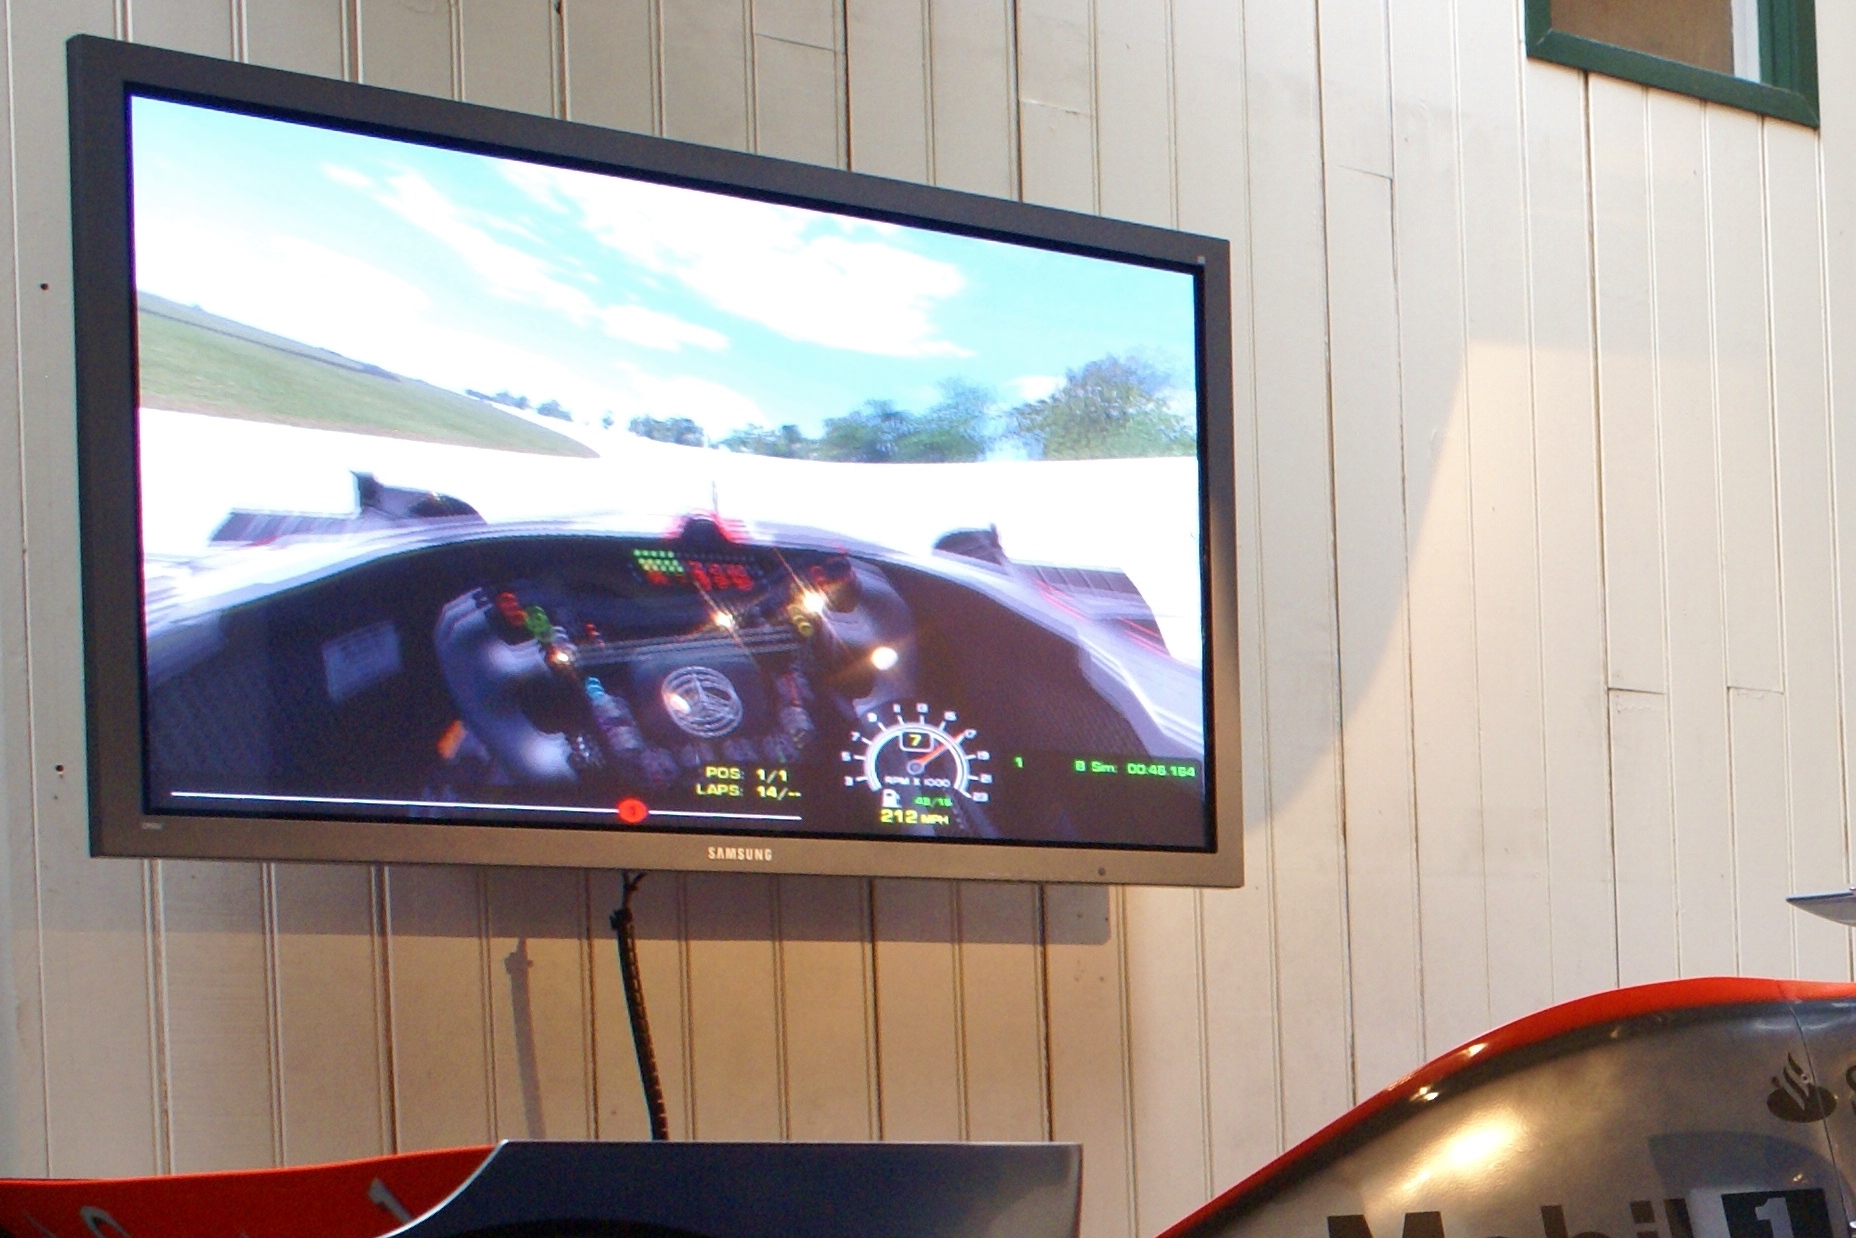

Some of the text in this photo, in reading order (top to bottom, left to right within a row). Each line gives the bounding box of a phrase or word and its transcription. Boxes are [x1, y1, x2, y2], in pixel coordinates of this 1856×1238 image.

[908, 734, 922, 746] 7
[705, 766, 788, 784] POS: 1/1
[695, 783, 744, 797] LAPS:
[880, 808, 949, 825] 212 MPH
[707, 846, 773, 861] SAMSUNG
